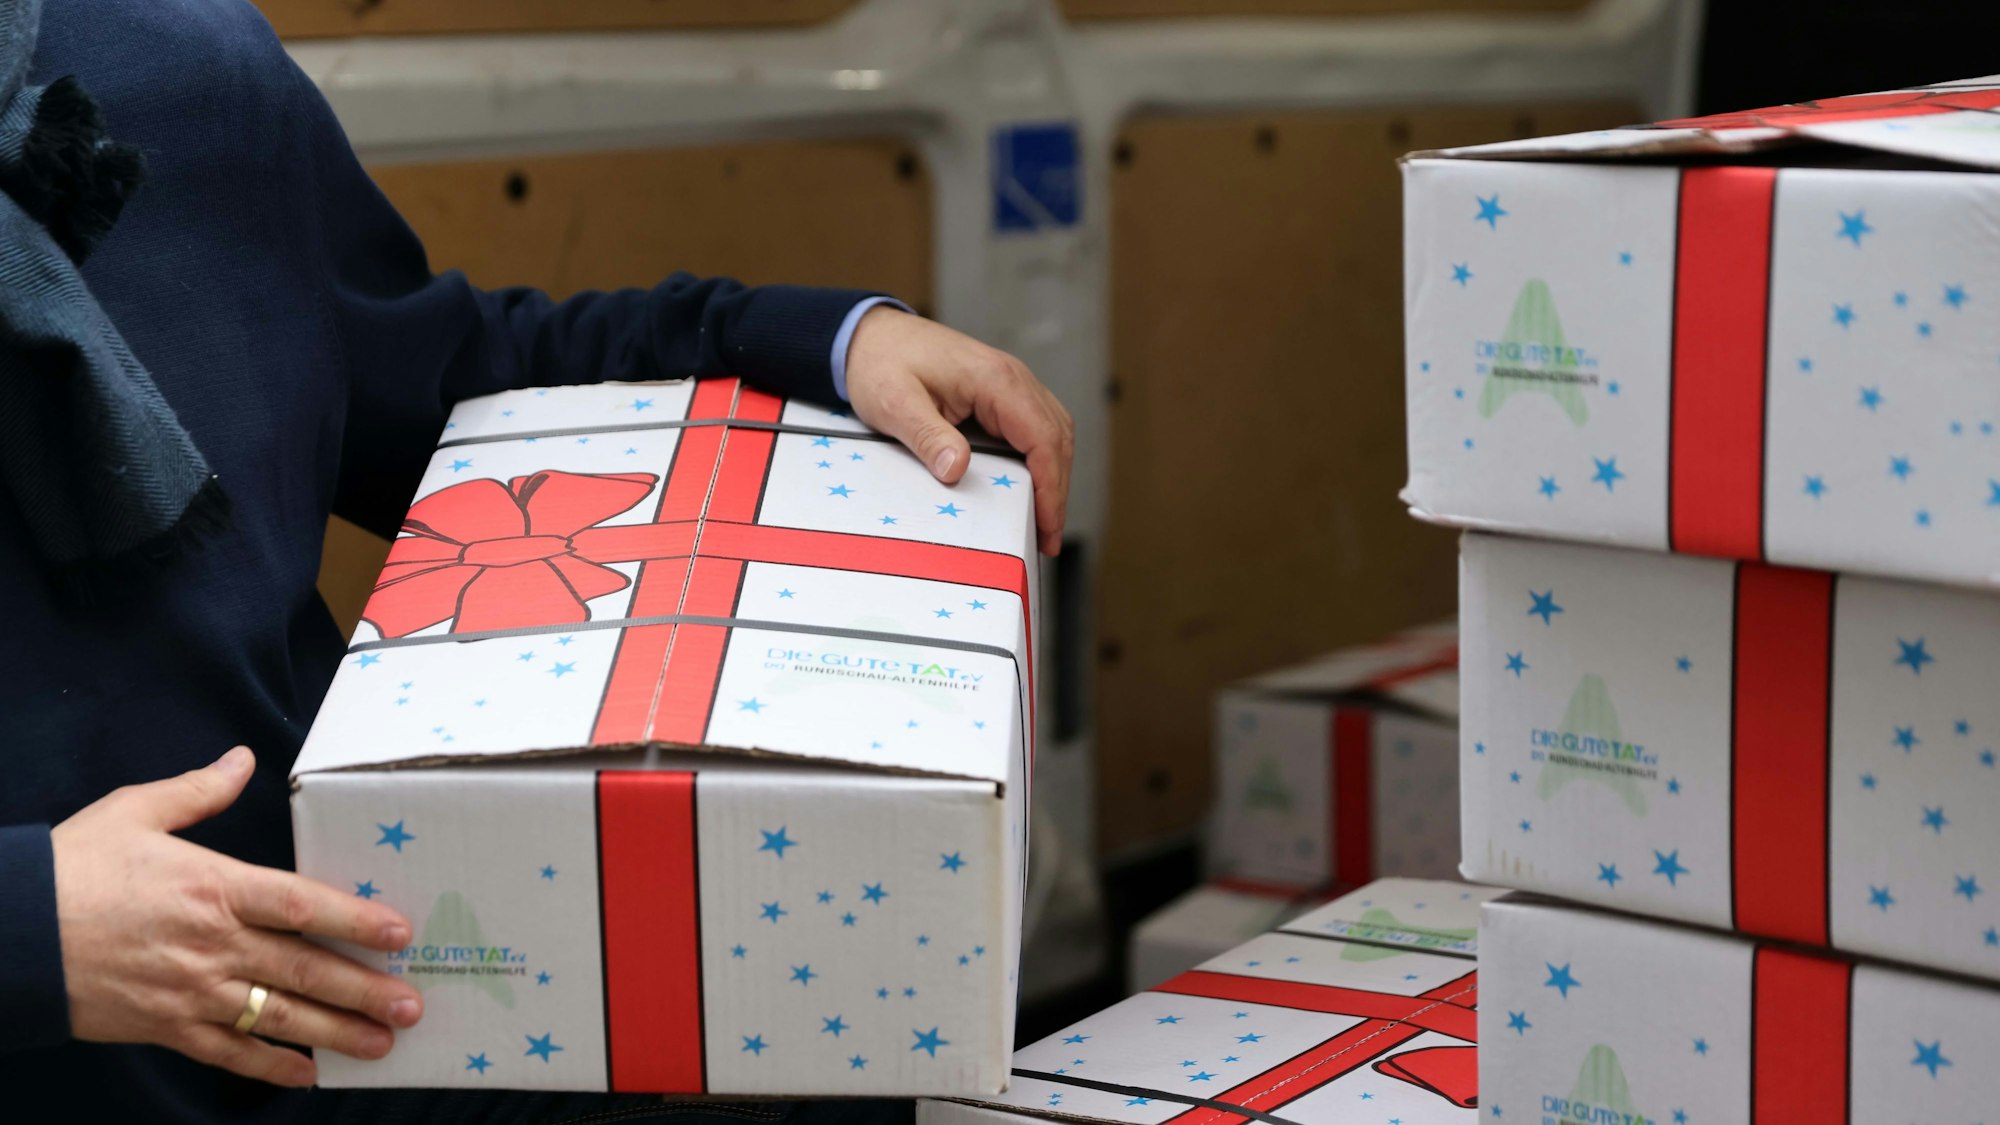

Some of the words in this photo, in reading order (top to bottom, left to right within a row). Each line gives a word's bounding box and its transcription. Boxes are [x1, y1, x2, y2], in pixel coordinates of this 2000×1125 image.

[793, 664, 981, 691] RUNDSCHAU-ALTENHILFE
[909, 661, 962, 680] TAT
[1611, 740, 1643, 763] TAT
[475, 946, 510, 962] TAT
